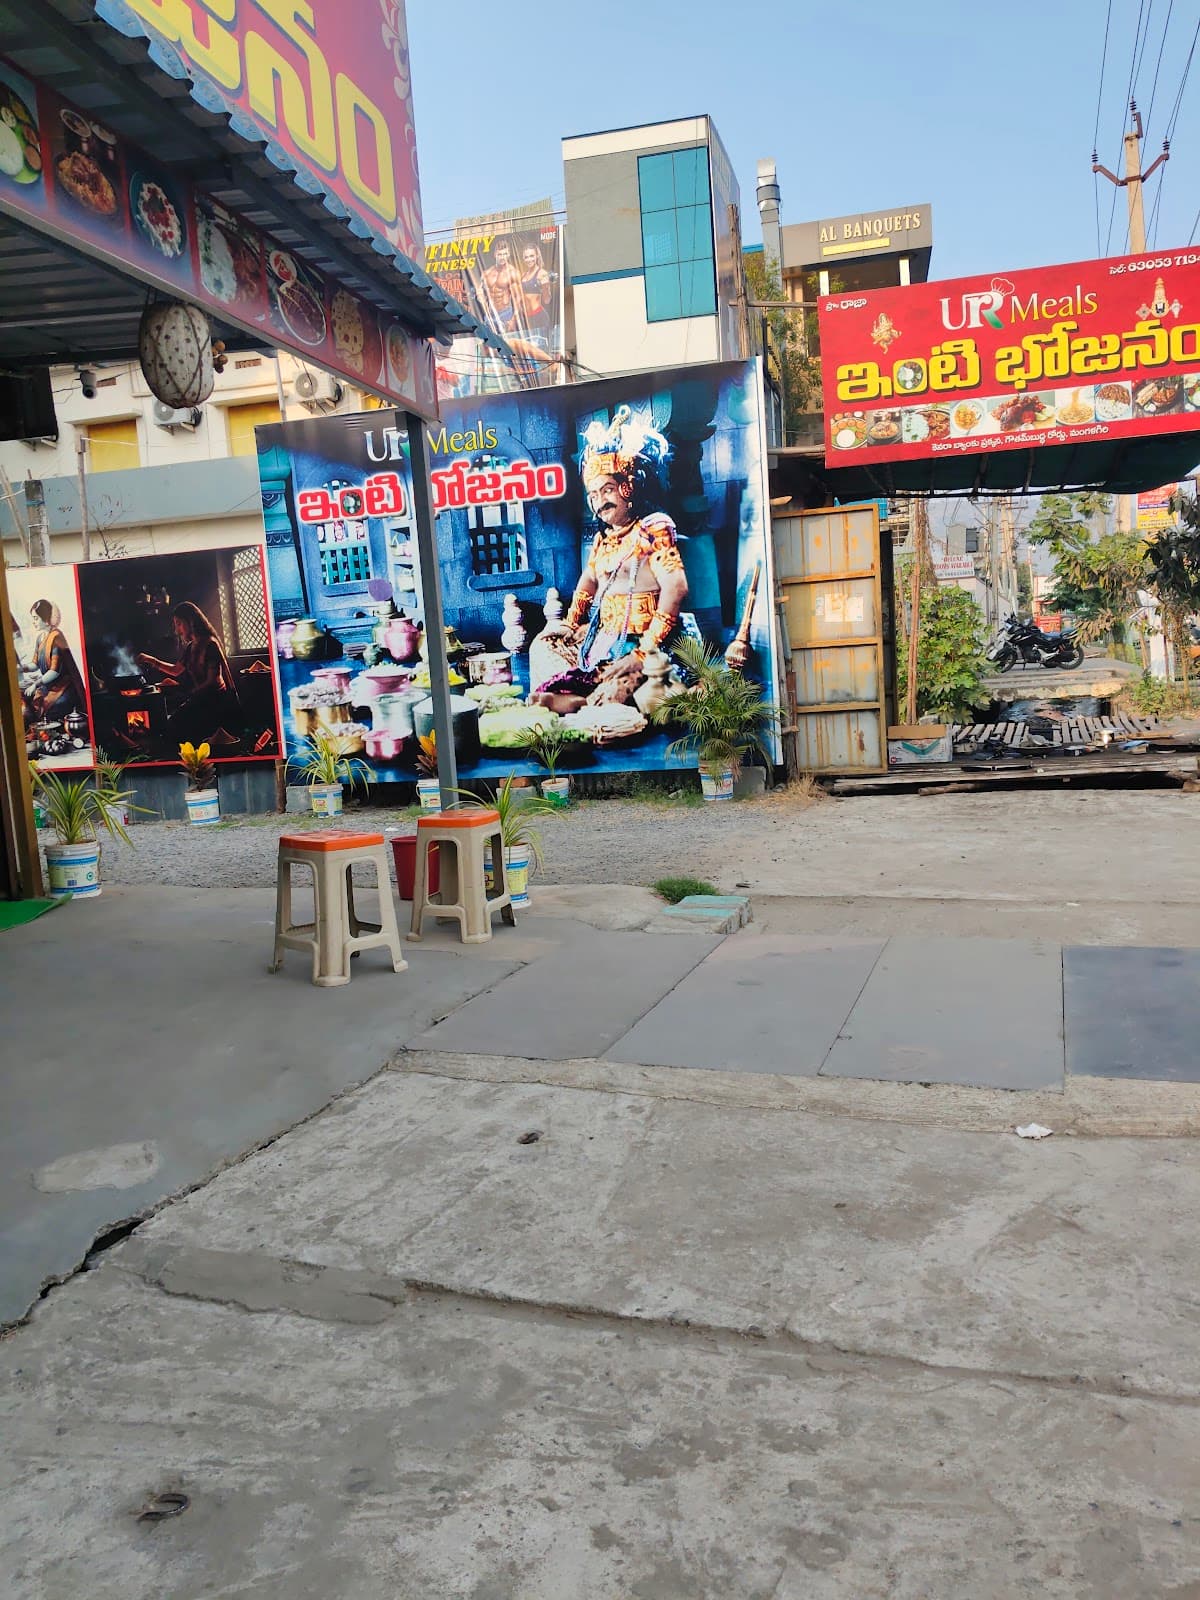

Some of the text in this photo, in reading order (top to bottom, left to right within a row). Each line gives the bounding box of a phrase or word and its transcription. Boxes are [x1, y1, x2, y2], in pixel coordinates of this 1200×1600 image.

[819, 212, 921, 242] AL BANQUETS
[425, 258, 476, 273] ITNESS
[1128, 257, 1172, 272] 63053
[1010, 285, 1098, 324] Meals
[837, 319, 1200, 402] ఇంటి భోజనం
[298, 473, 403, 521] ఇంటి
